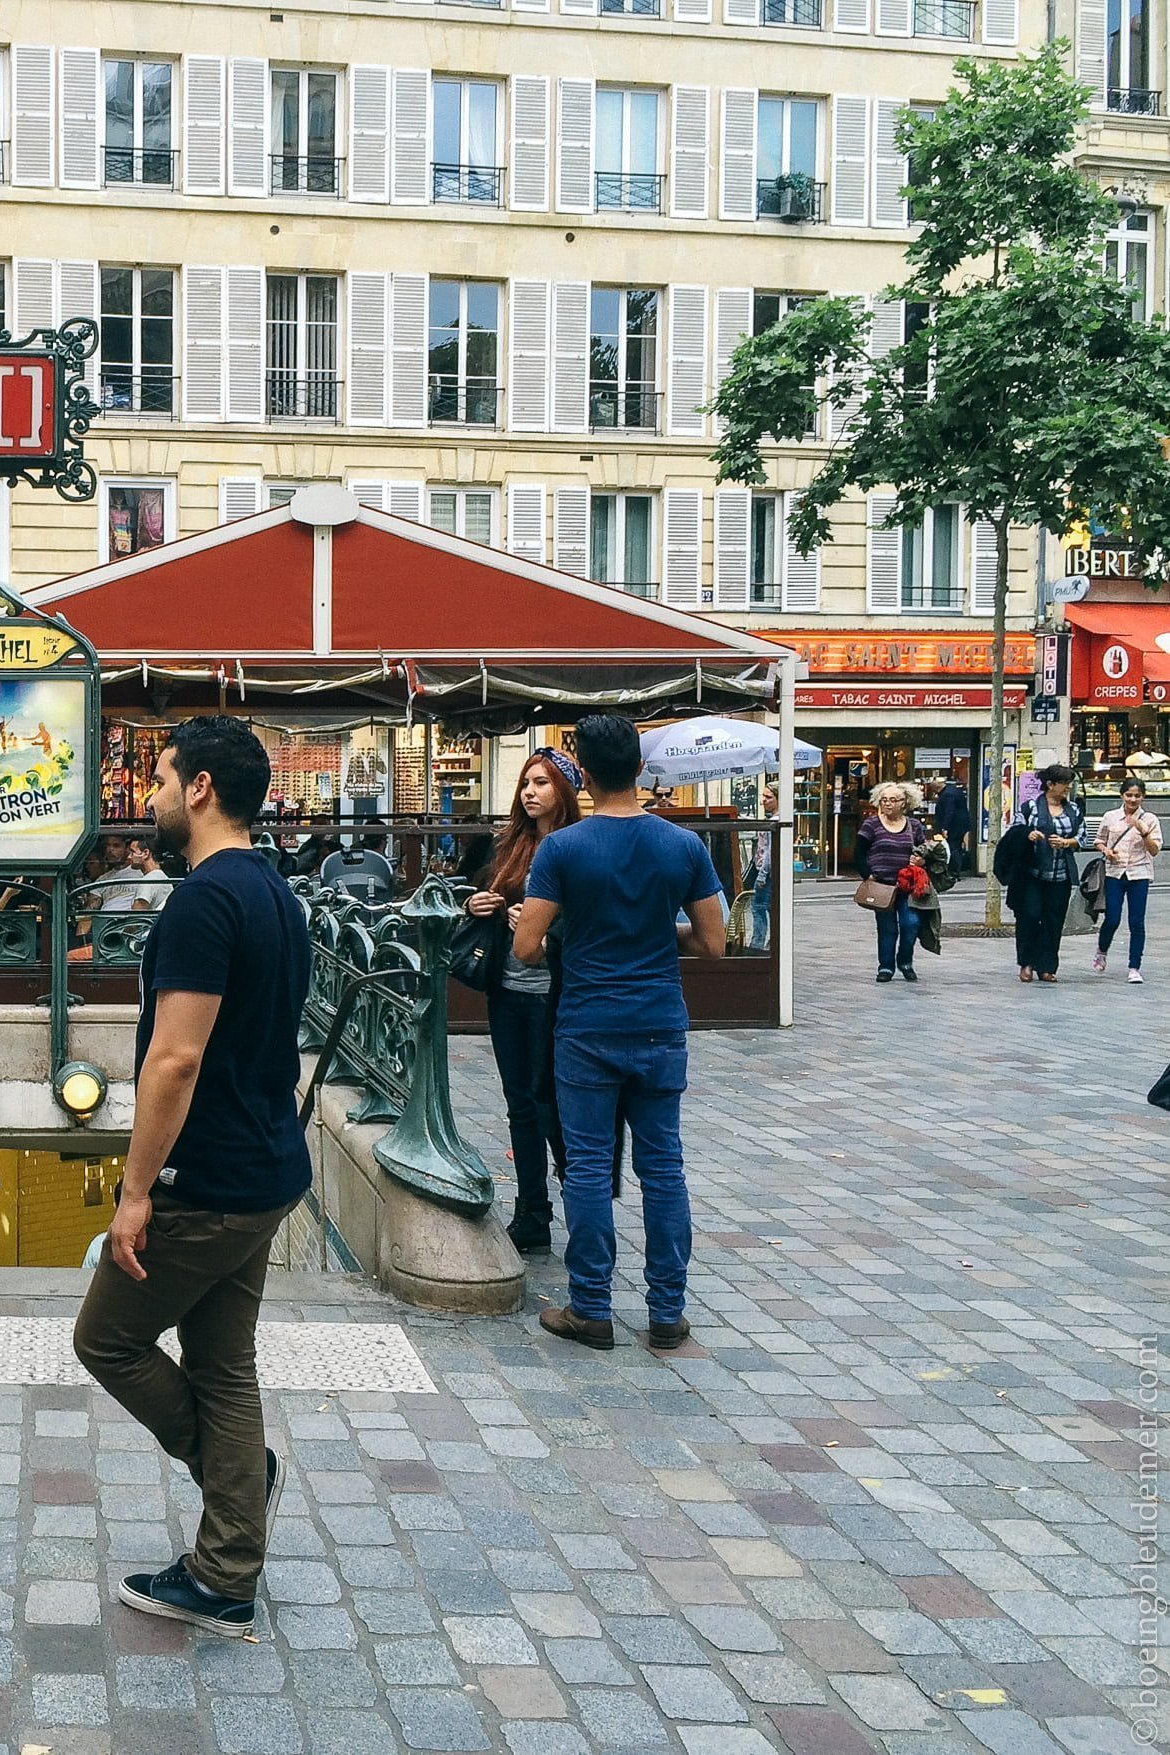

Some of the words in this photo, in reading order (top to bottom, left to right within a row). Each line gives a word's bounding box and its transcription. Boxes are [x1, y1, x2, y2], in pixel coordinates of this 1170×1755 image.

[1055, 586, 1071, 596] PMU
[845, 642, 918, 668] SAINT
[1045, 636, 1058, 695] LOTO
[1094, 685, 1137, 698] CREPES
[795, 694, 814, 703] ARES
[832, 693, 869, 705] TABAC
[877, 693, 915, 705] SAINT
[924, 693, 966, 705] MICHEL
[24, 801, 61, 819] VERT
